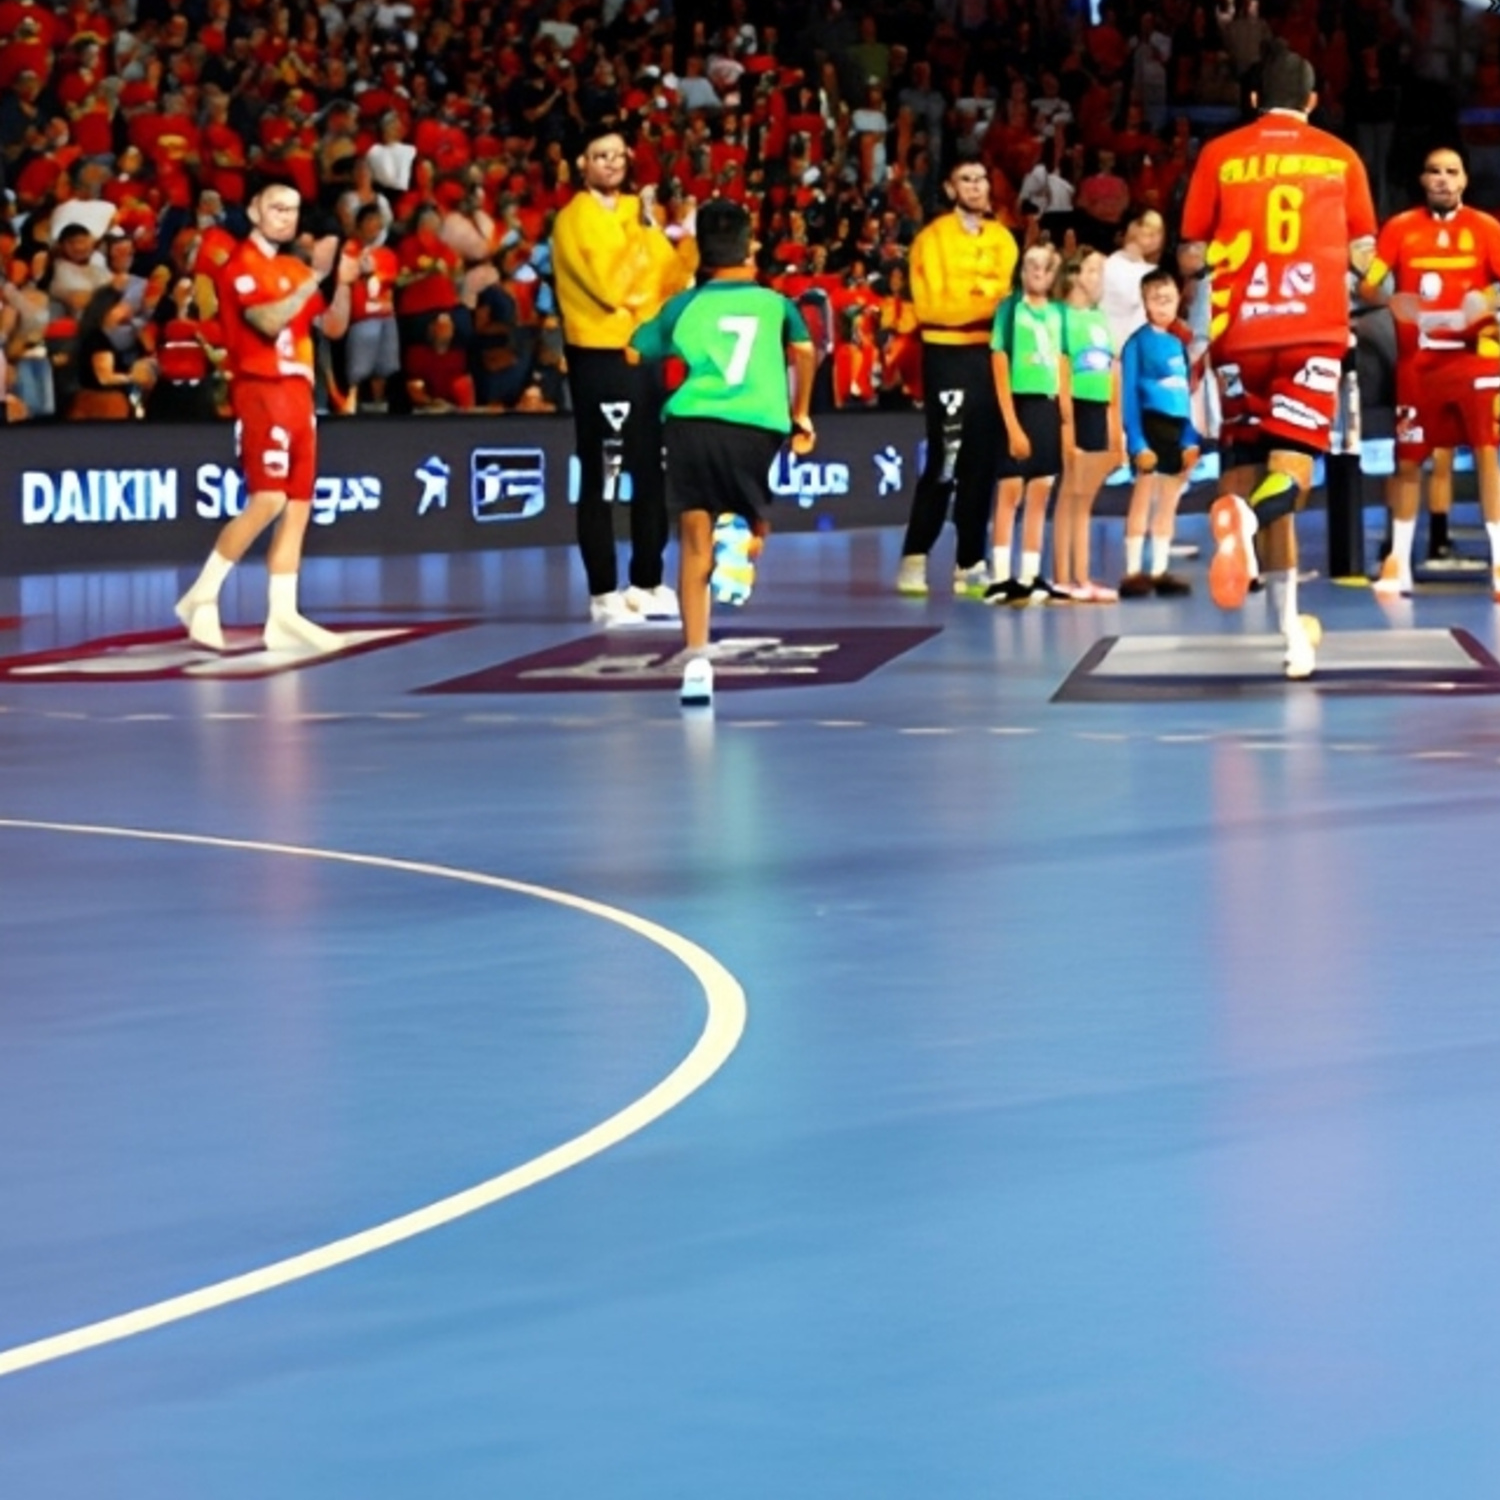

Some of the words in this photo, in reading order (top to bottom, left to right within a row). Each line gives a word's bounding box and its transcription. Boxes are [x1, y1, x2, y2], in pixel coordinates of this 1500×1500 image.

[1266, 184, 1304, 254] 6
[718, 314, 759, 386] 7
[22, 468, 178, 525] DAIKIN
